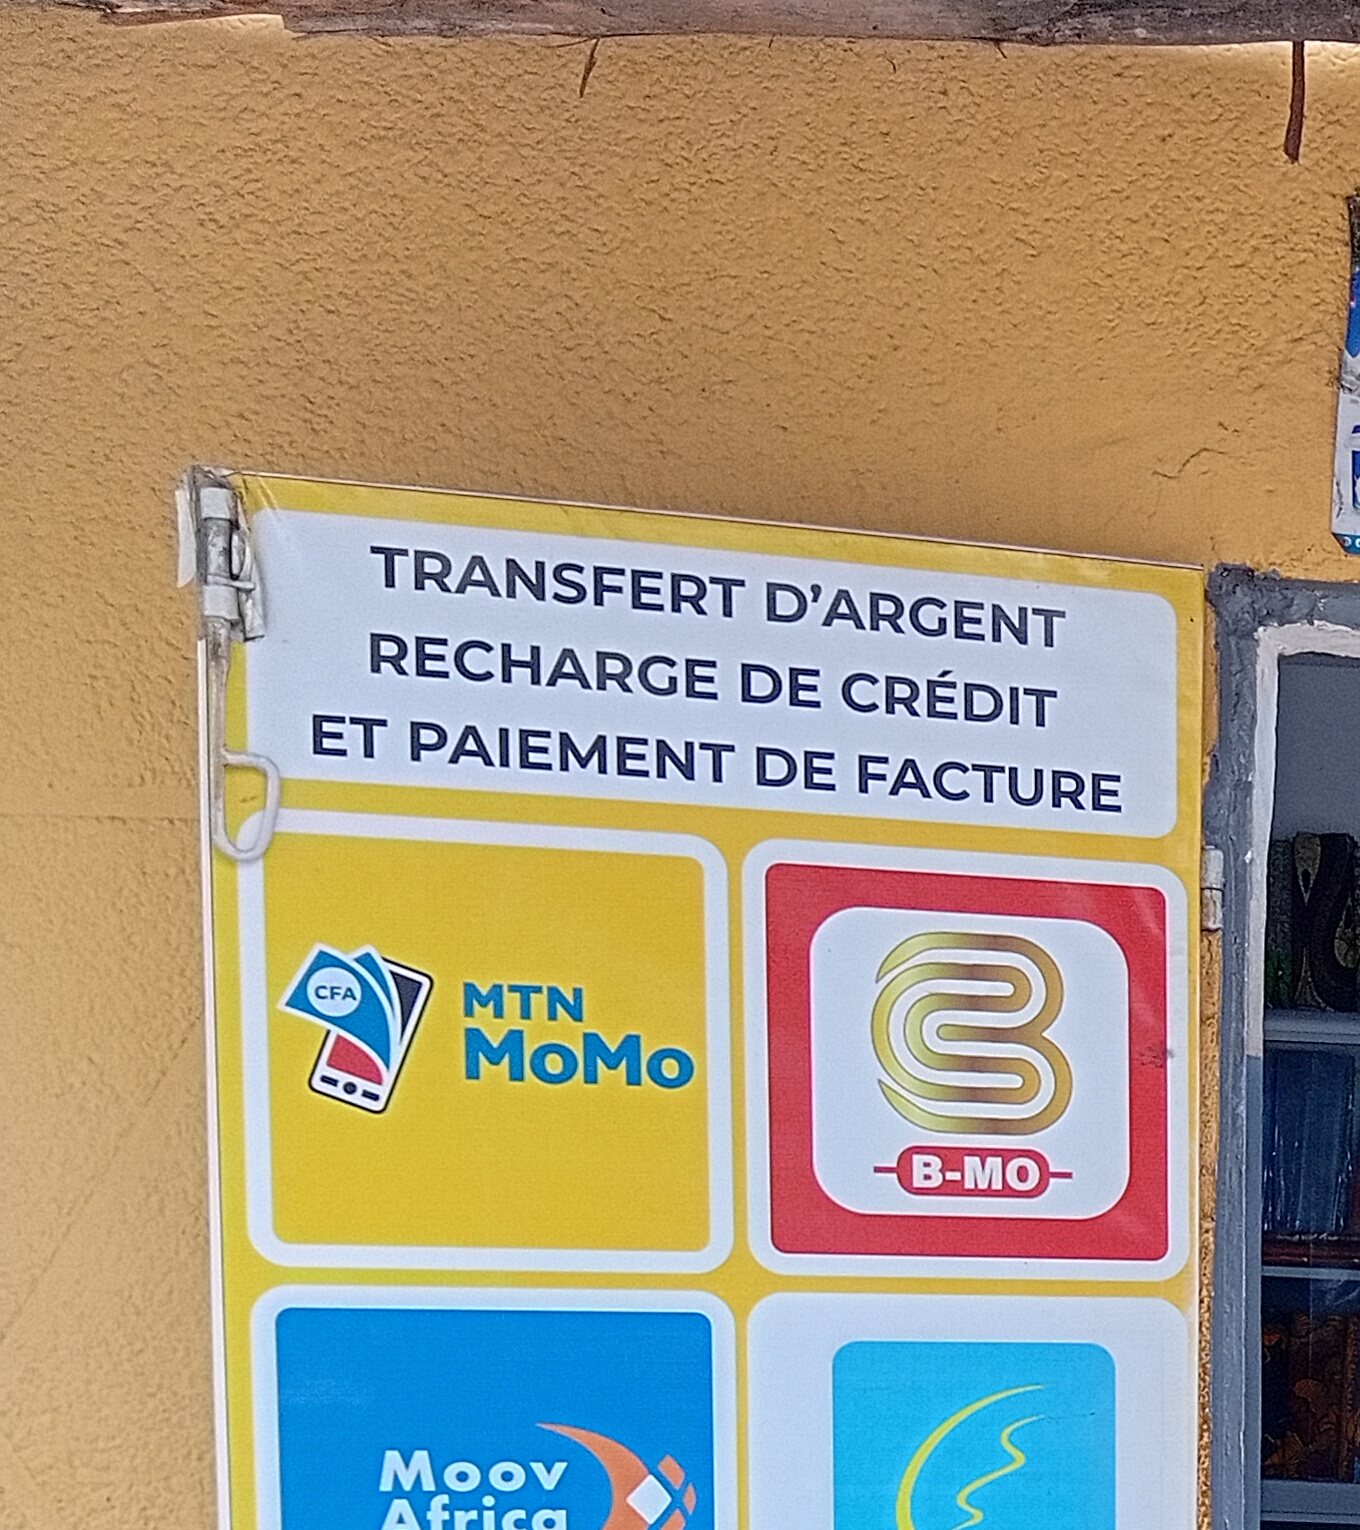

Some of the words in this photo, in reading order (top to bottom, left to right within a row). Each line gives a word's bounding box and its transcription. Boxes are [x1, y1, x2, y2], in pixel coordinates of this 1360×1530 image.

[369, 544, 746, 620] TRANSFERT
[765, 582, 1066, 649] D’ARGENT
[368, 632, 718, 697] RECHARGE
[740, 663, 822, 708] DE
[840, 669, 1058, 728] CRÉDIT
[310, 713, 388, 759] ET
[409, 721, 735, 784] PAIEMENT
[753, 746, 835, 789] DE
[856, 754, 1123, 814] FACTURE
[314, 983, 357, 1004] CFA
[463, 981, 584, 1022] MTN
[463, 1028, 696, 1090] MoMo
[910, 1152, 1042, 1192] B-MO
[379, 1448, 568, 1492] Moov
